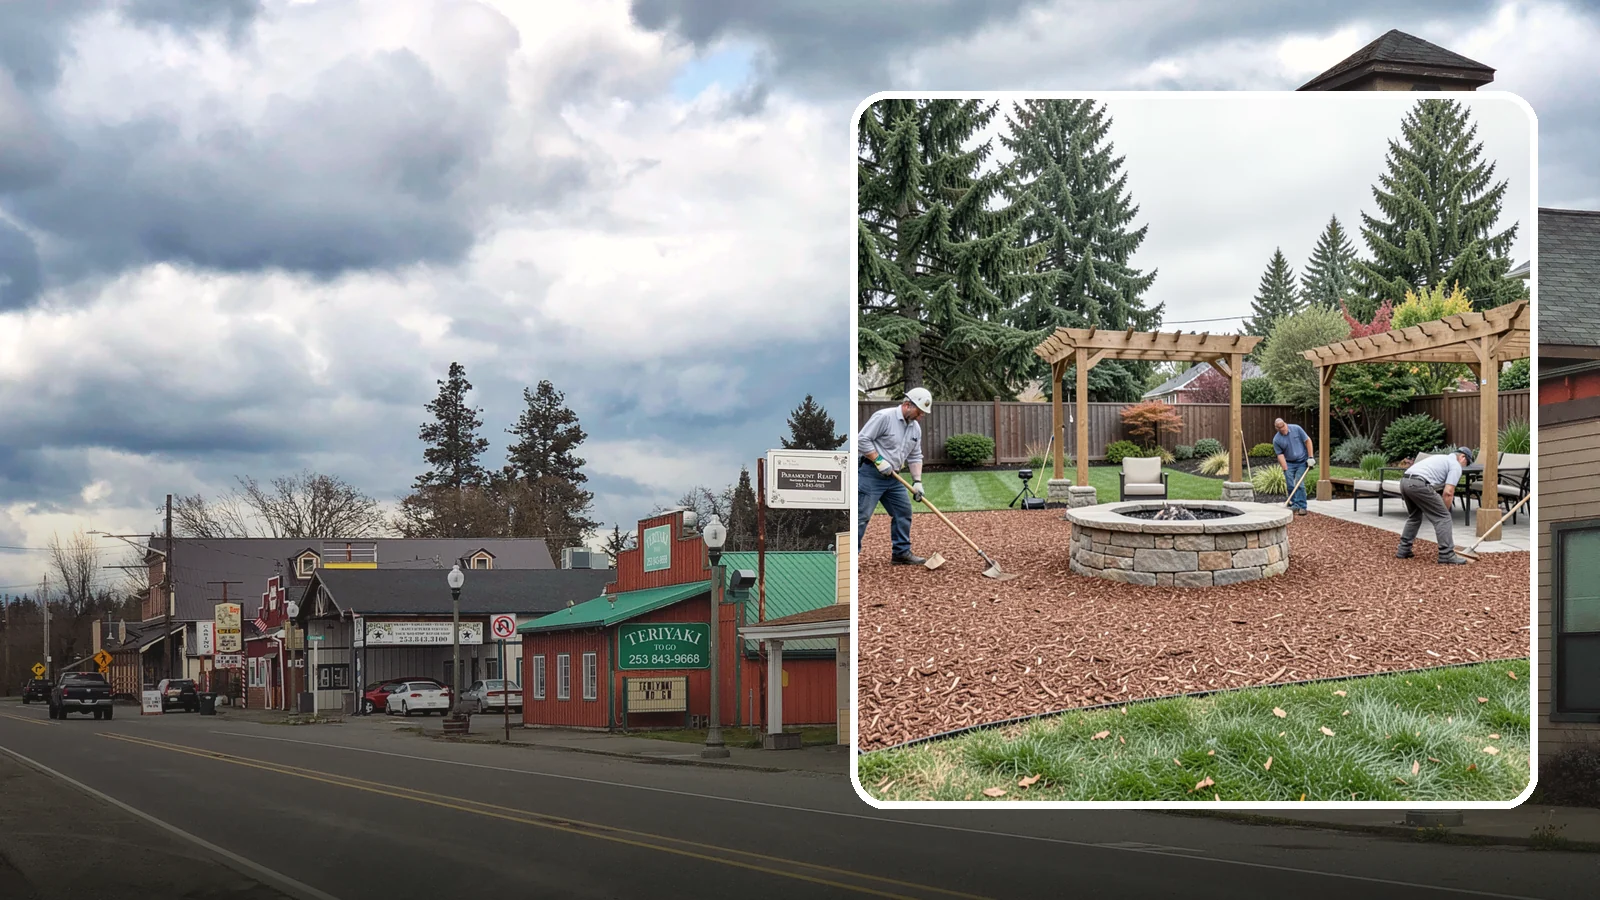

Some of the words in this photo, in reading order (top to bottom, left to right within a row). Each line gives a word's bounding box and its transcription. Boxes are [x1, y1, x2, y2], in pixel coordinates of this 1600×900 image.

[625, 627, 702, 646] TERIYAKI
[629, 654, 648, 664] 253
[651, 653, 700, 664] 843-9668
